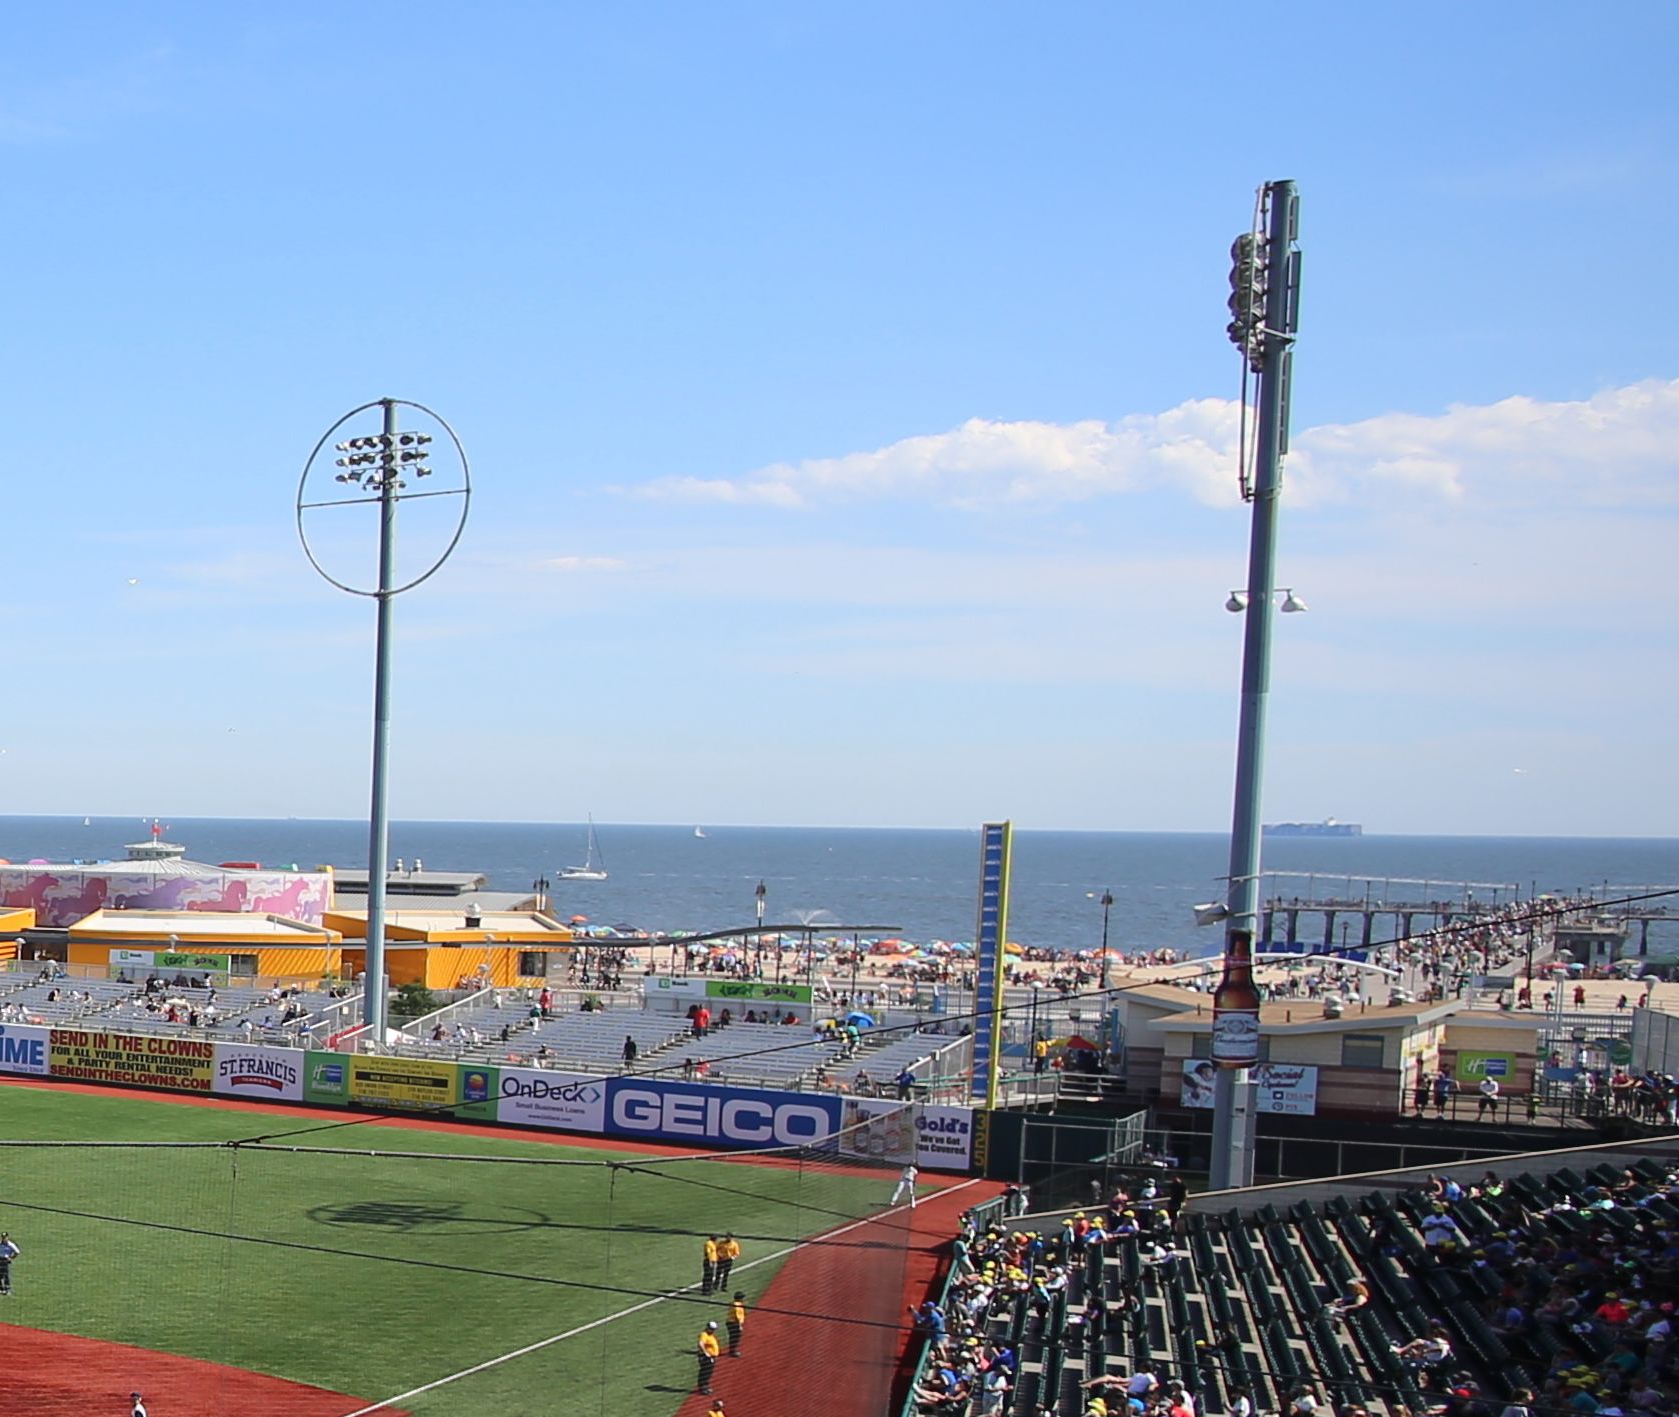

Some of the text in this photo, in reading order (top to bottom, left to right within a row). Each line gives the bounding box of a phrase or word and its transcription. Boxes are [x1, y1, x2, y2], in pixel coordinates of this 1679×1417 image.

[50, 1029, 213, 1059] SEND IN THE CLOWNS
[51, 1046, 211, 1069] FOR ALL YOUR ENTERTAINMENT
[67, 1058, 193, 1077] & PARTY RENTAL NEEDS!
[1261, 1064, 1305, 1080] Social
[50, 1065, 211, 1091] SENDINTHECLOWNS.COM
[502, 1076, 583, 1102] OnDeck
[515, 1101, 585, 1114] Small Business Loans
[612, 1088, 830, 1145] GEICO
[915, 1116, 969, 1134] Gold's
[920, 1134, 960, 1145] We've Got
[930, 1144, 967, 1155] Covered.
